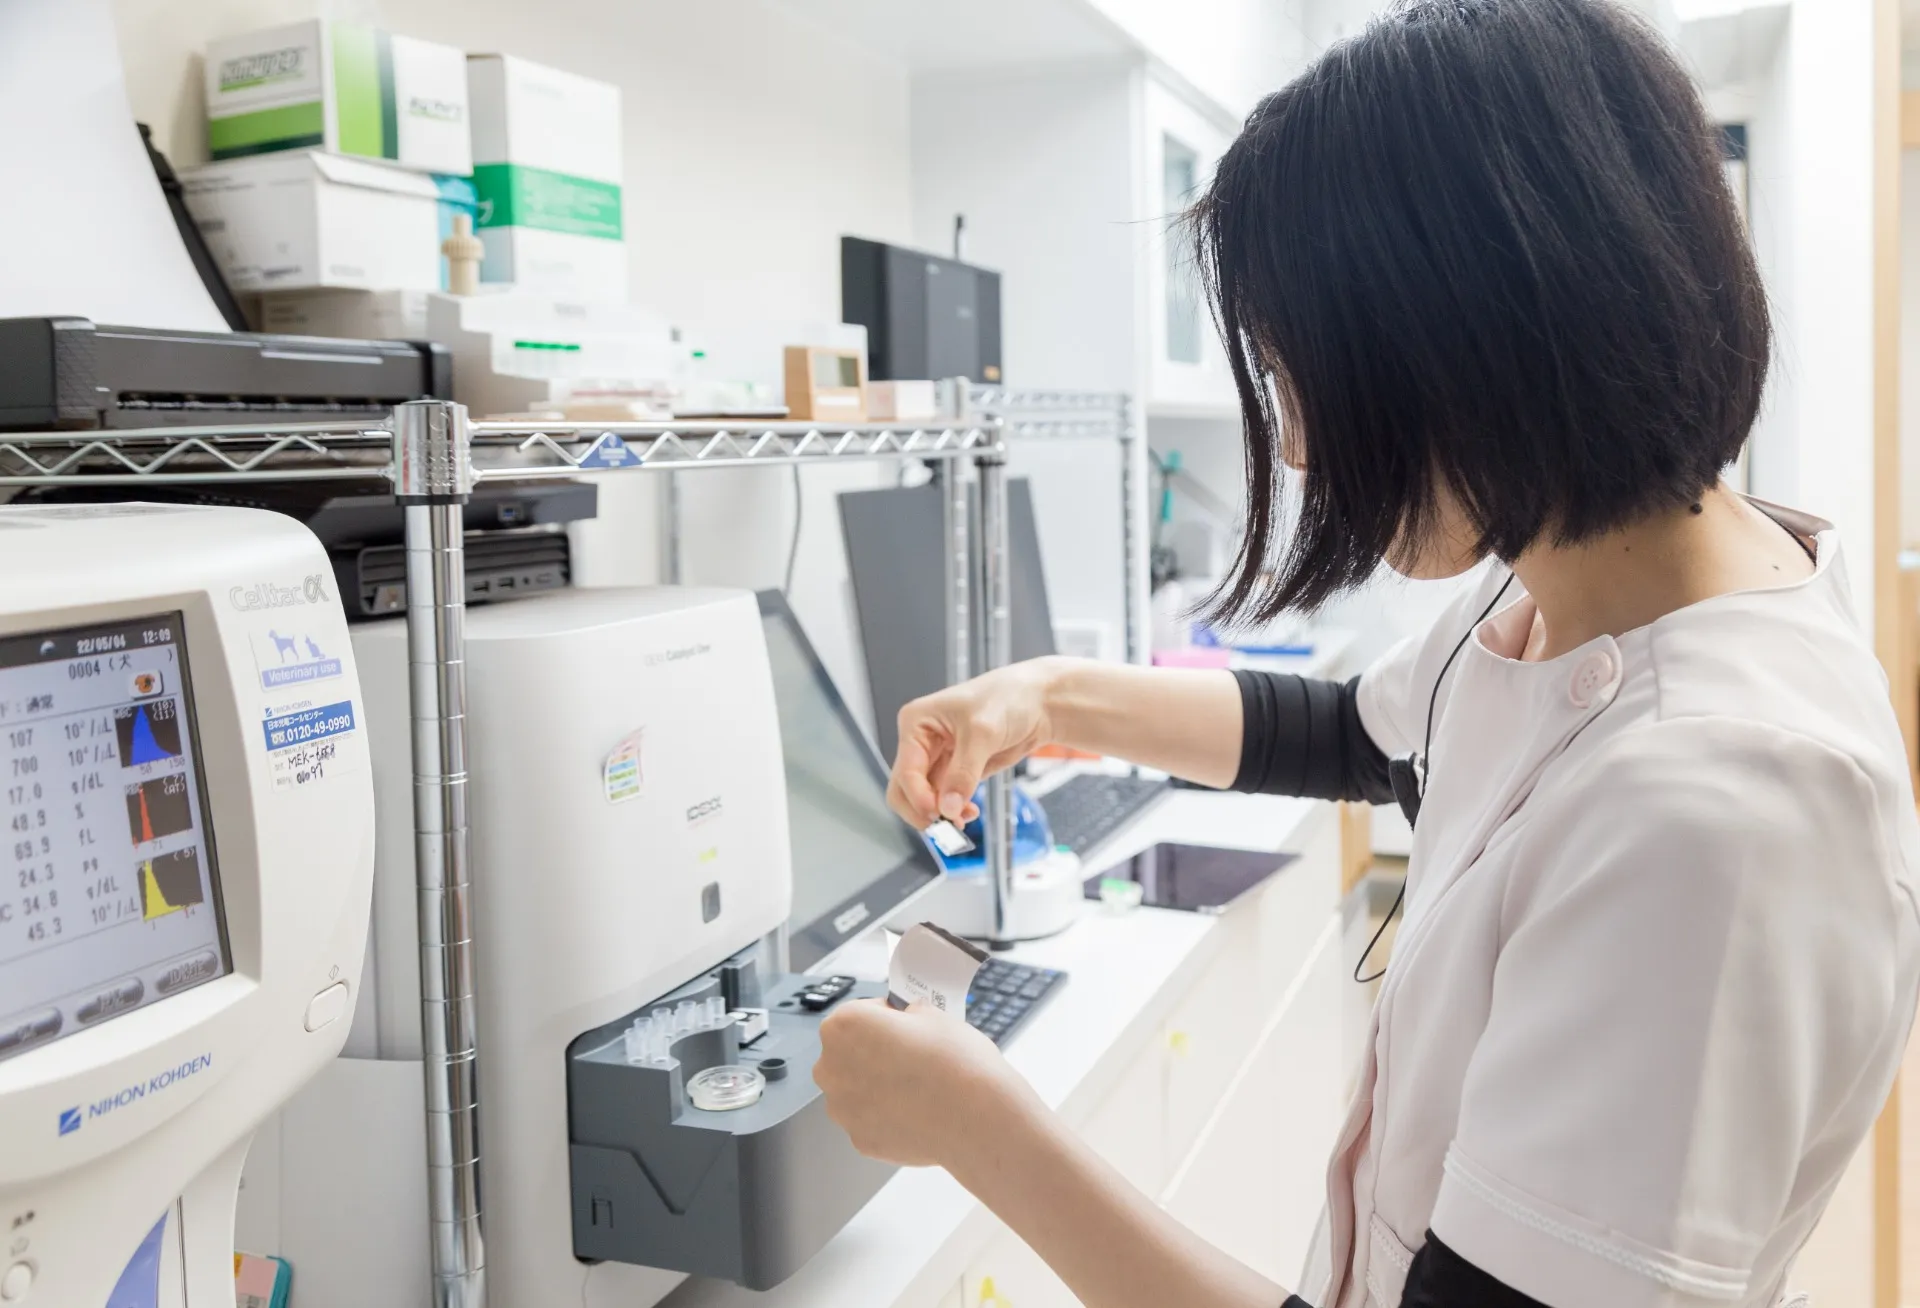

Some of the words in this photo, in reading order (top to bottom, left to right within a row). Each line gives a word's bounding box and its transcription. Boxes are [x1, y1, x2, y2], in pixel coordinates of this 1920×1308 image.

[77, 634, 126, 655] 22/05/04
[143, 628, 171, 645] 12:09
[69, 660, 101, 680] 0004
[268, 665, 319, 684] Veterinary
[320, 662, 337, 675] use
[9, 728, 34, 749] 107
[286, 714, 351, 742] 0120-49-0990
[12, 755, 38, 777] 700
[89, 1083, 146, 1119] NIHON
[149, 1052, 213, 1094] KOHDEN
